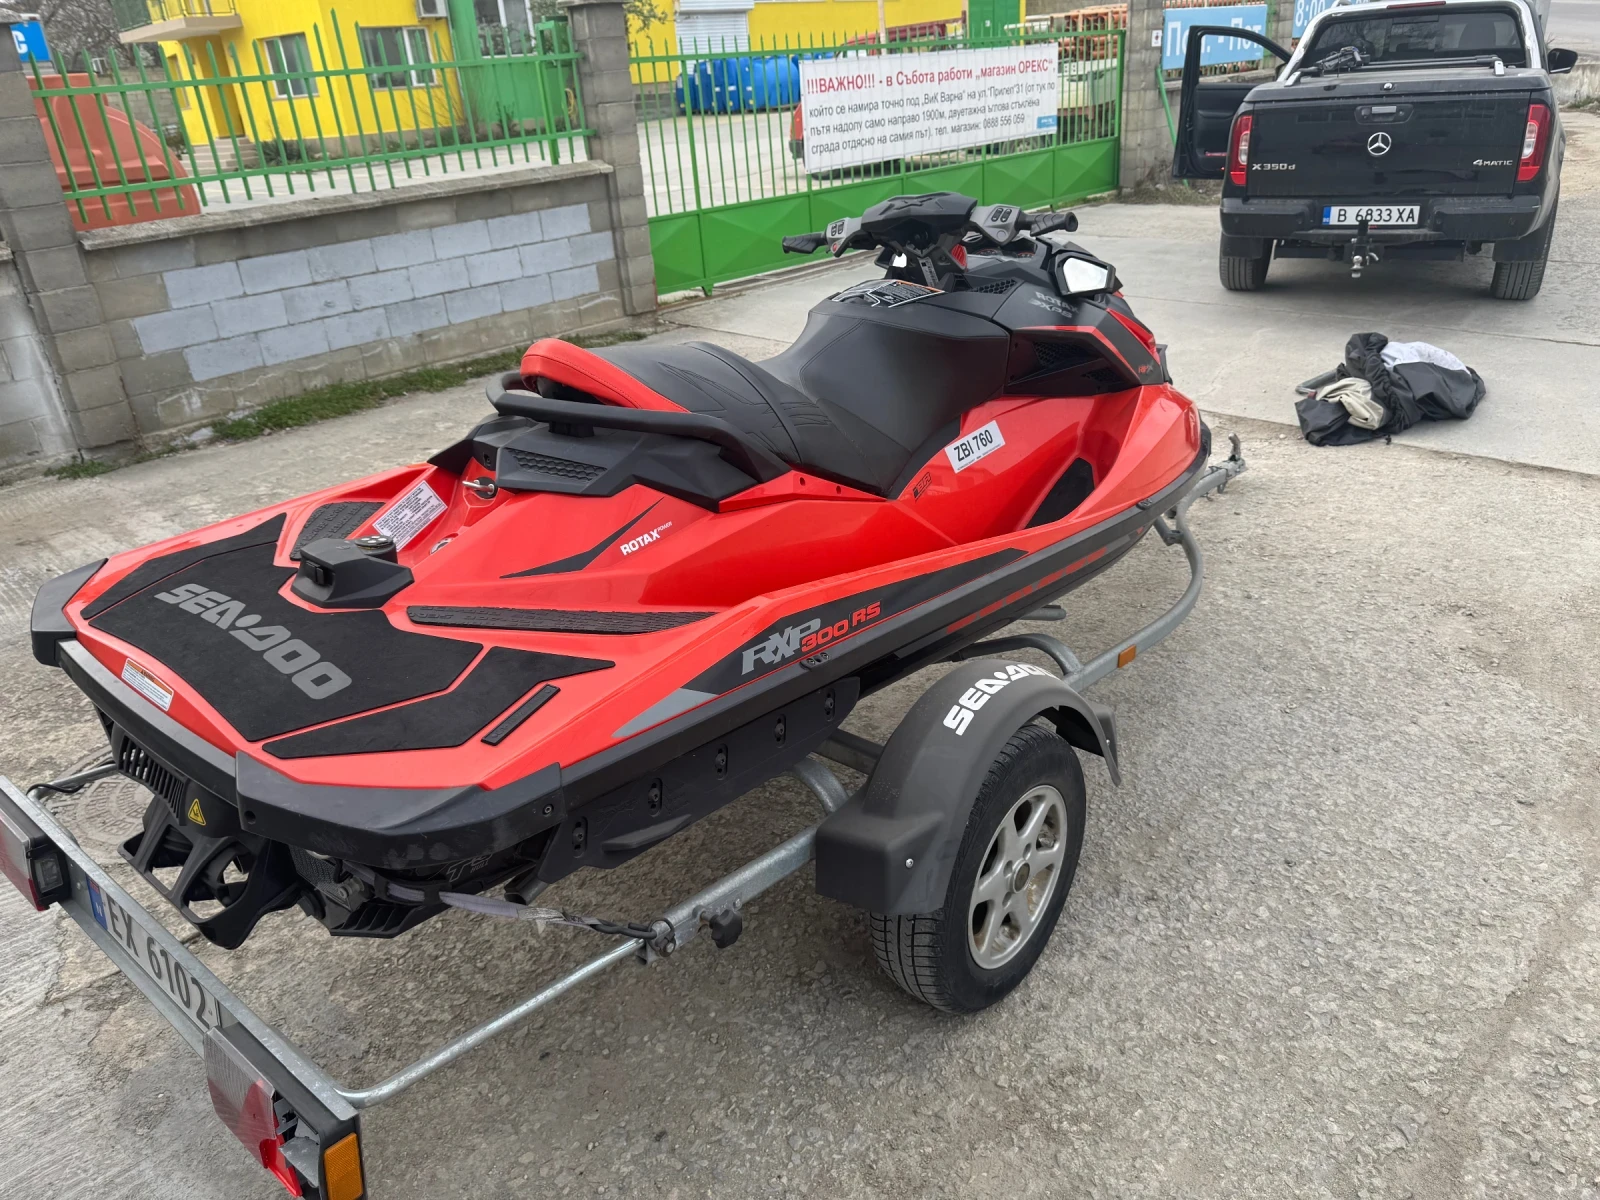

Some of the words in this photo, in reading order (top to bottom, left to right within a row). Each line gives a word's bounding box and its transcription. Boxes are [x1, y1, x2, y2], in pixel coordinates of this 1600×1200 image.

[1166, 21, 1210, 57] По.
[807, 73, 875, 94] !!!ВАЖНО!!!
[886, 76, 893, 86] в
[896, 69, 935, 86] Събота
[938, 67, 972, 85] работи
[809, 105, 834, 118] който
[836, 105, 846, 115] се
[848, 100, 879, 115] намира
[881, 98, 905, 110] точно
[906, 97, 919, 108] под
[967, 91, 976, 100] на
[1036, 82, 1046, 94] тук
[1047, 82, 1055, 91] по
[810, 125, 831, 137] пътя
[833, 120, 862, 133] надолу
[864, 117, 885, 129] само
[887, 113, 920, 127] направо
[948, 104, 986, 120] двуетажна
[811, 141, 840, 155] сграда
[842, 136, 875, 150] отдясно
[877, 135, 887, 145] на
[889, 131, 913, 143] самия
[1337, 208, 1347, 222] B
[1355, 208, 1392, 222] 6833
[1395, 208, 1415, 222] XA
[954, 440, 974, 462] ZBI
[972, 429, 993, 451] 760
[620, 528, 660, 556] ROTAX
[741, 618, 821, 676] RXP
[801, 620, 849, 652] 300
[851, 601, 881, 627] RS
[106, 893, 140, 958] EX
[147, 936, 210, 1030] 6102
